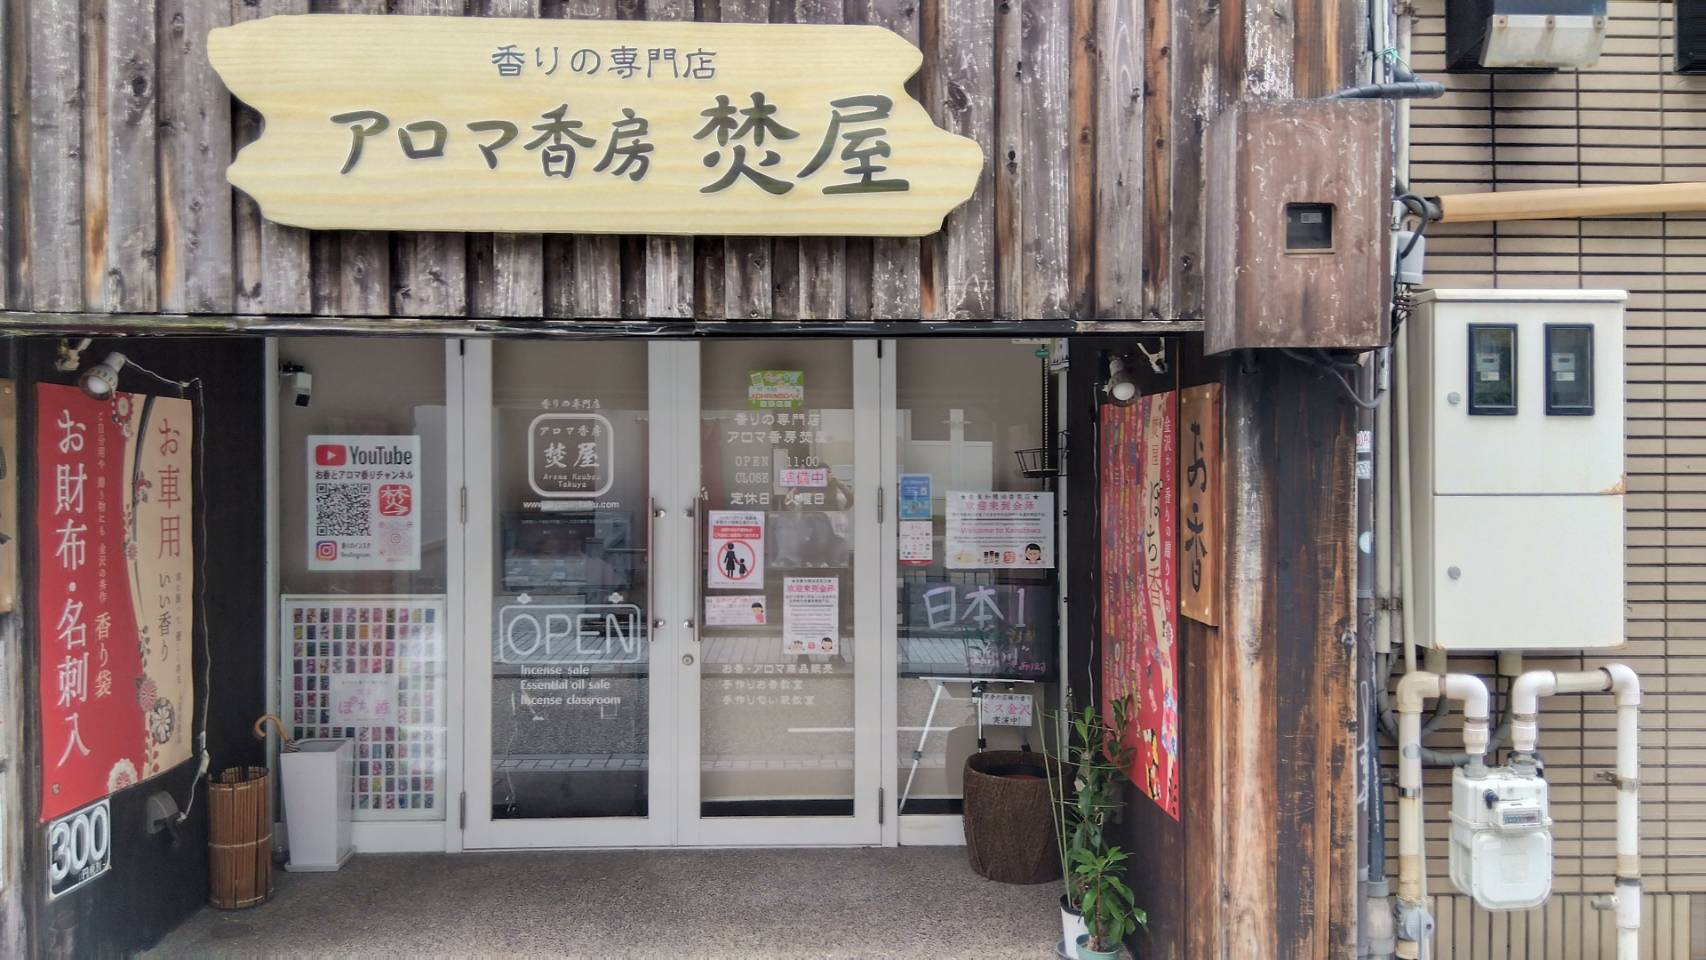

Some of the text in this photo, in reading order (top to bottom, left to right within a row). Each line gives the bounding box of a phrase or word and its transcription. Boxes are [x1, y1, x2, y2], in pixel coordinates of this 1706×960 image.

[491, 44, 717, 80] 香りの専門店
[330, 91, 910, 195] アロマ香房 焚屋
[541, 399, 601, 409] 香りの専門店
[734, 413, 820, 426] 香りの専門店
[540, 425, 602, 436] アロマ香房
[349, 446, 413, 465] YouTube
[543, 442, 601, 468] 焚屋
[735, 456, 769, 467] OPEN
[735, 473, 769, 484] CLOSE
[157, 418, 181, 560] お車用
[730, 493, 770, 505] 定休日
[55, 409, 91, 768] お財布・名刺入
[507, 614, 634, 656] OPEN
[95, 612, 112, 699] 香り袋
[520, 664, 590, 675] Incense sale
[520, 680, 611, 690] Essential oil sale
[520, 694, 621, 705] Incense classroom
[50, 806, 107, 881] 300
